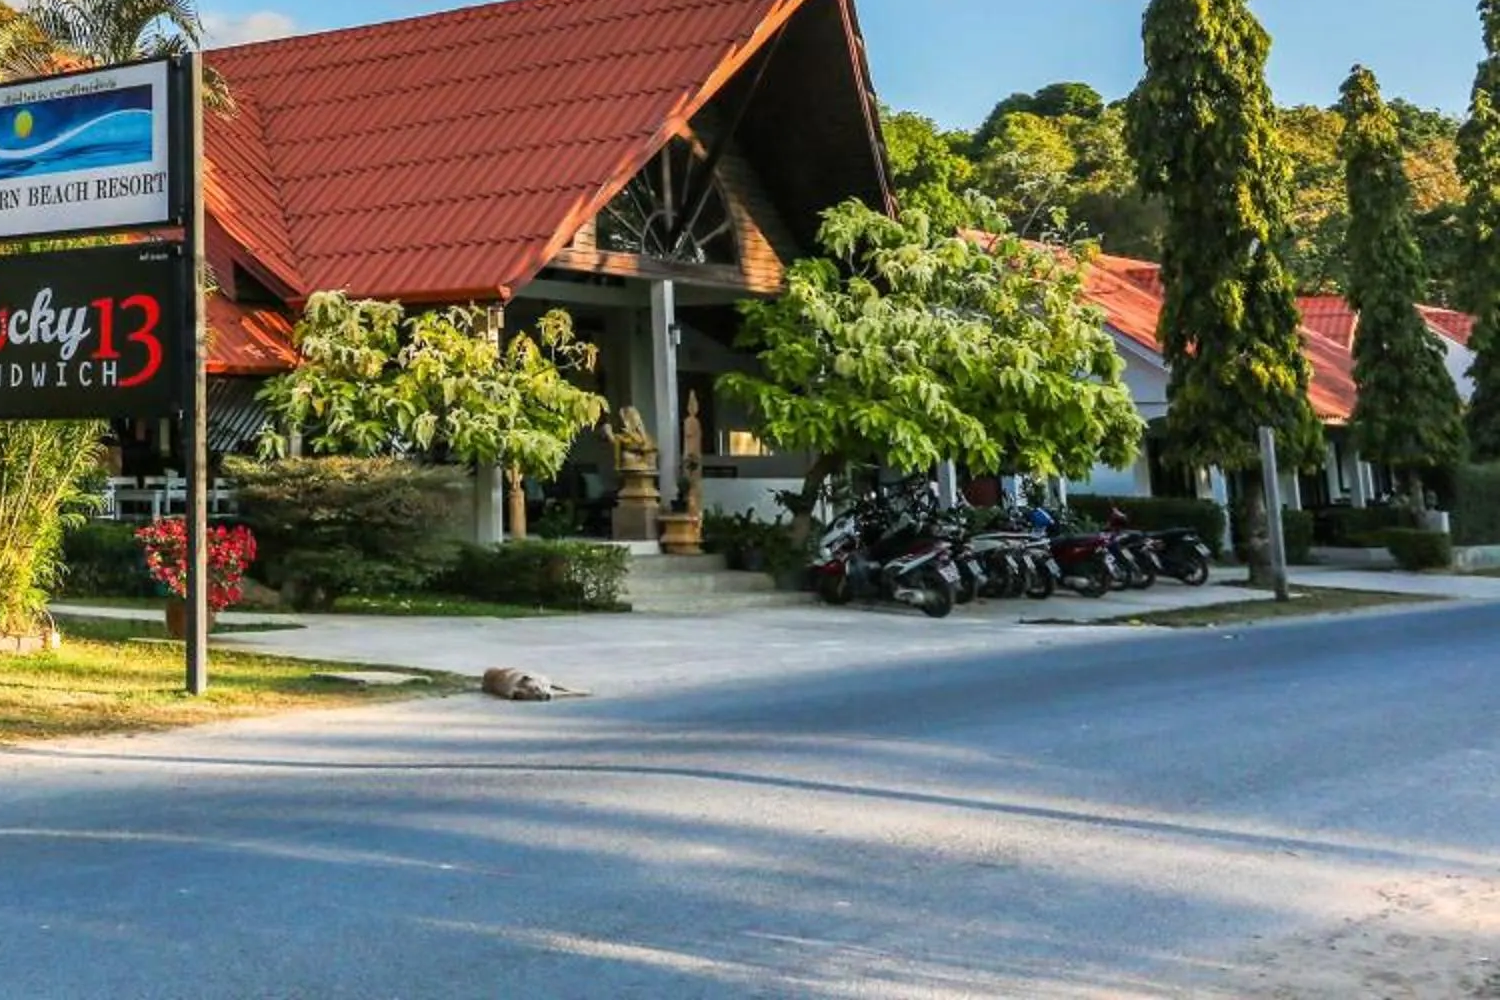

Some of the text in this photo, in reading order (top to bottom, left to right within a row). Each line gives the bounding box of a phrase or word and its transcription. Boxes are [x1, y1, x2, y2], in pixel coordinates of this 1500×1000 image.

[28, 181, 88, 206] BEACH
[95, 172, 167, 199] RESORT
[91, 293, 164, 387] 13
